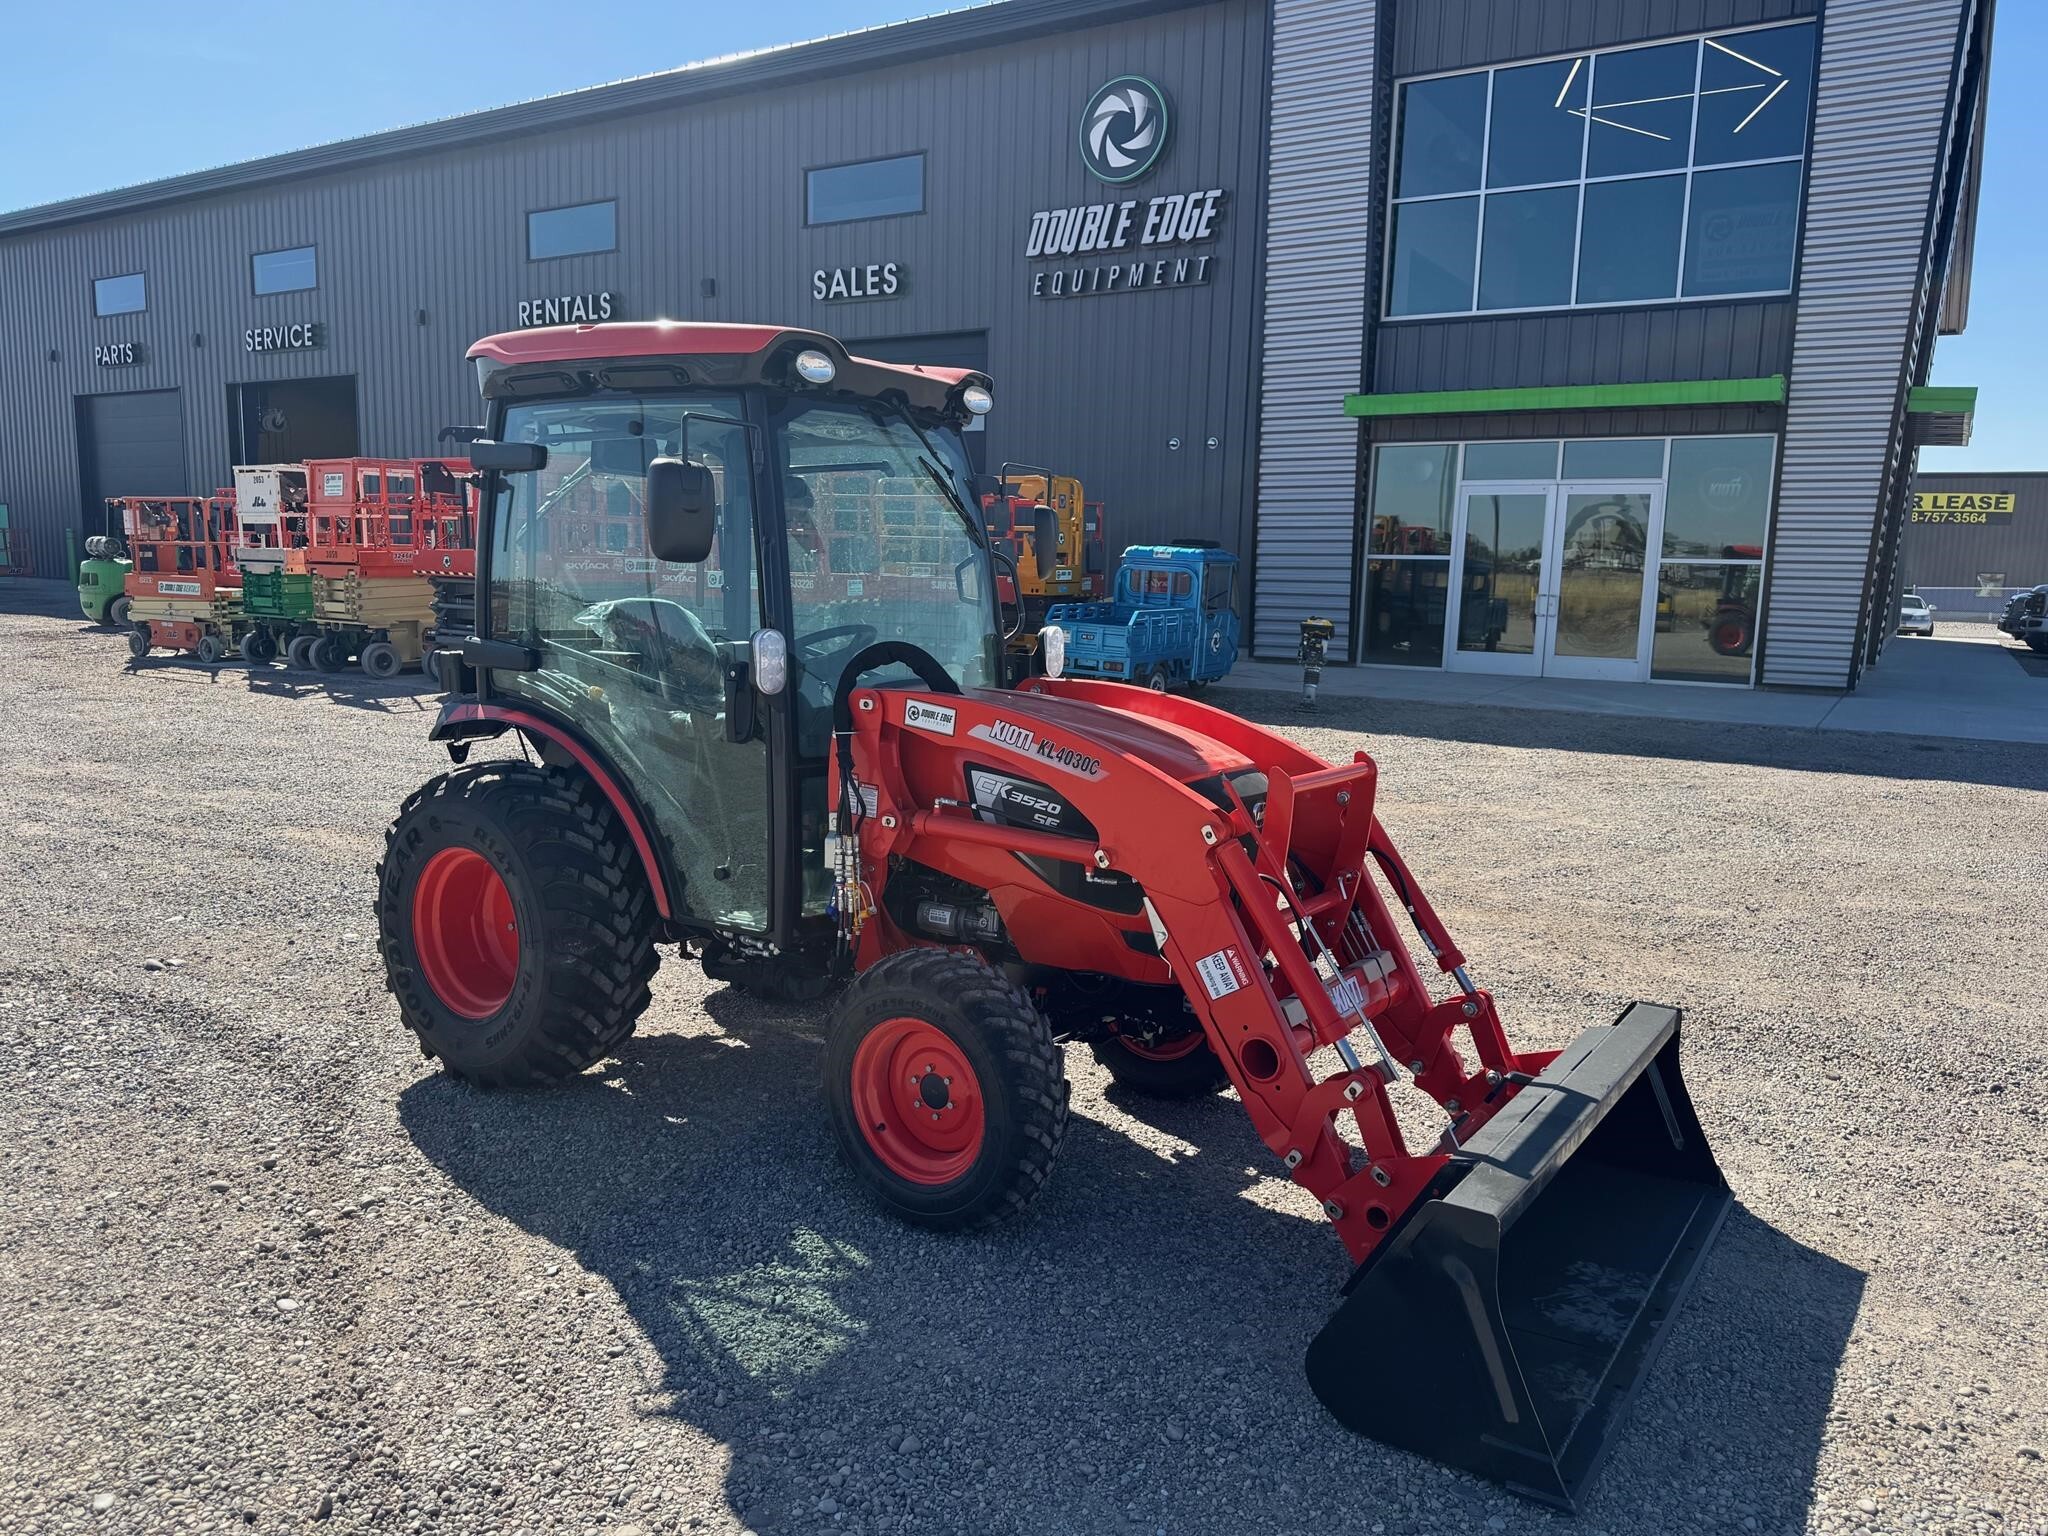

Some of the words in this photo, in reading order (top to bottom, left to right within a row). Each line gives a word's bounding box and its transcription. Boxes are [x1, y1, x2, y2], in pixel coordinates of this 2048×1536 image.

[1025, 201, 1136, 257] DOUBLE
[1141, 189, 1222, 245] EDGE
[813, 262, 898, 301] SALES
[1033, 256, 1210, 296] EQUIPMENT
[518, 291, 611, 327] RENTALS
[95, 343, 133, 366] PARTS
[245, 323, 313, 351] SERVICE
[1931, 495, 2009, 511] LEASE
[566, 559, 609, 571] SKYJACK
[989, 719, 1035, 751] KIOTI
[1036, 739, 1101, 776] KL4030C
[1211, 953, 1226, 971] KEEP
[1219, 972, 1236, 991] AWAY
[1231, 956, 1249, 986] WARNING
